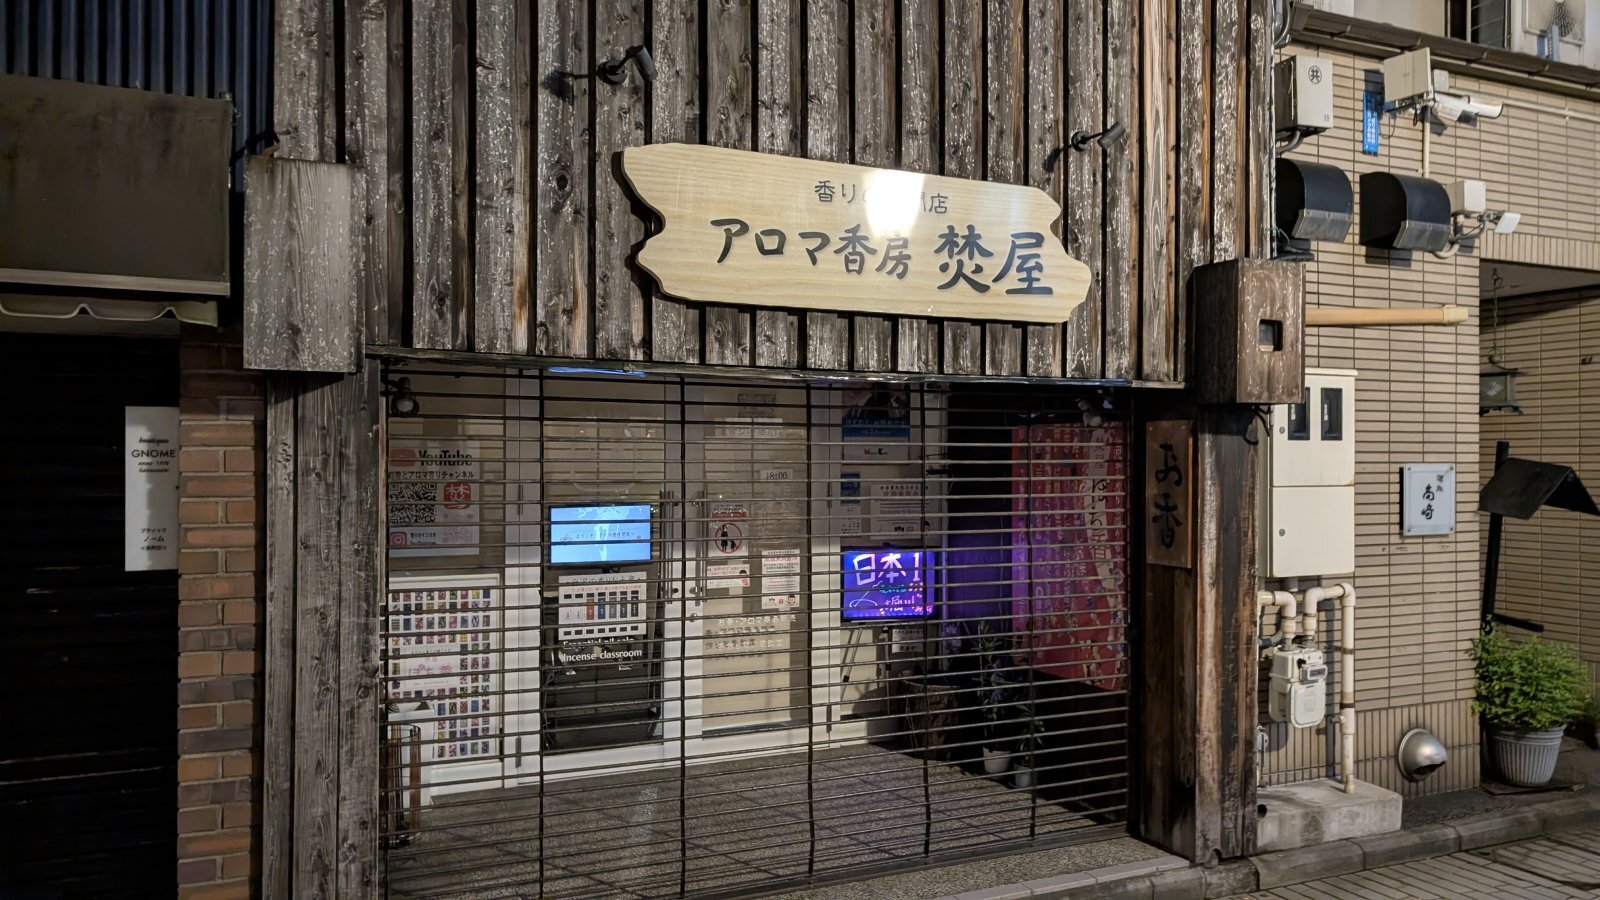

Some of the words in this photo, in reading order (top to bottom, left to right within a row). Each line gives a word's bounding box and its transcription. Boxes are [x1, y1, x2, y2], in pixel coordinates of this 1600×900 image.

[814, 180, 949, 214] 香り店
[710, 217, 912, 280] アロマ香房
[933, 224, 1053, 295] 焚屋
[131, 449, 176, 458] GNOME
[418, 449, 473, 467] YouTube
[765, 471, 788, 480] 18:00
[1151, 442, 1183, 549] お香
[562, 653, 598, 663] Incense
[599, 648, 642, 660] classroom
